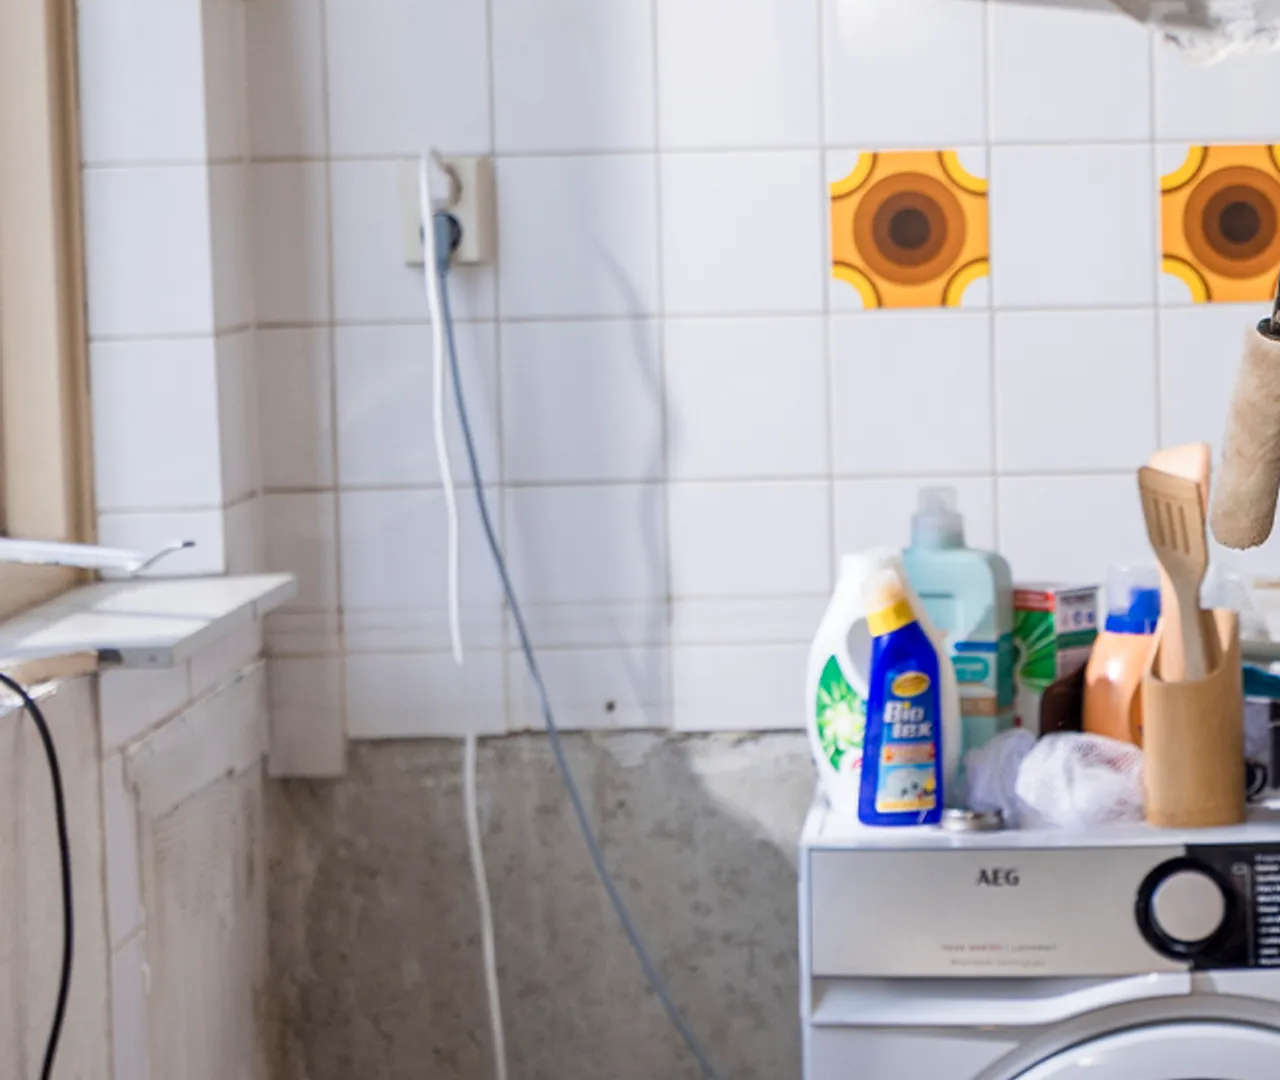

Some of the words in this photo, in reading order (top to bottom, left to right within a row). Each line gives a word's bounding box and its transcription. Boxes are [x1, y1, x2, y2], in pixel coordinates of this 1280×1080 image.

[883, 700, 925, 723] Bio
[891, 721, 932, 738] tex
[976, 867, 1020, 887] AEG
